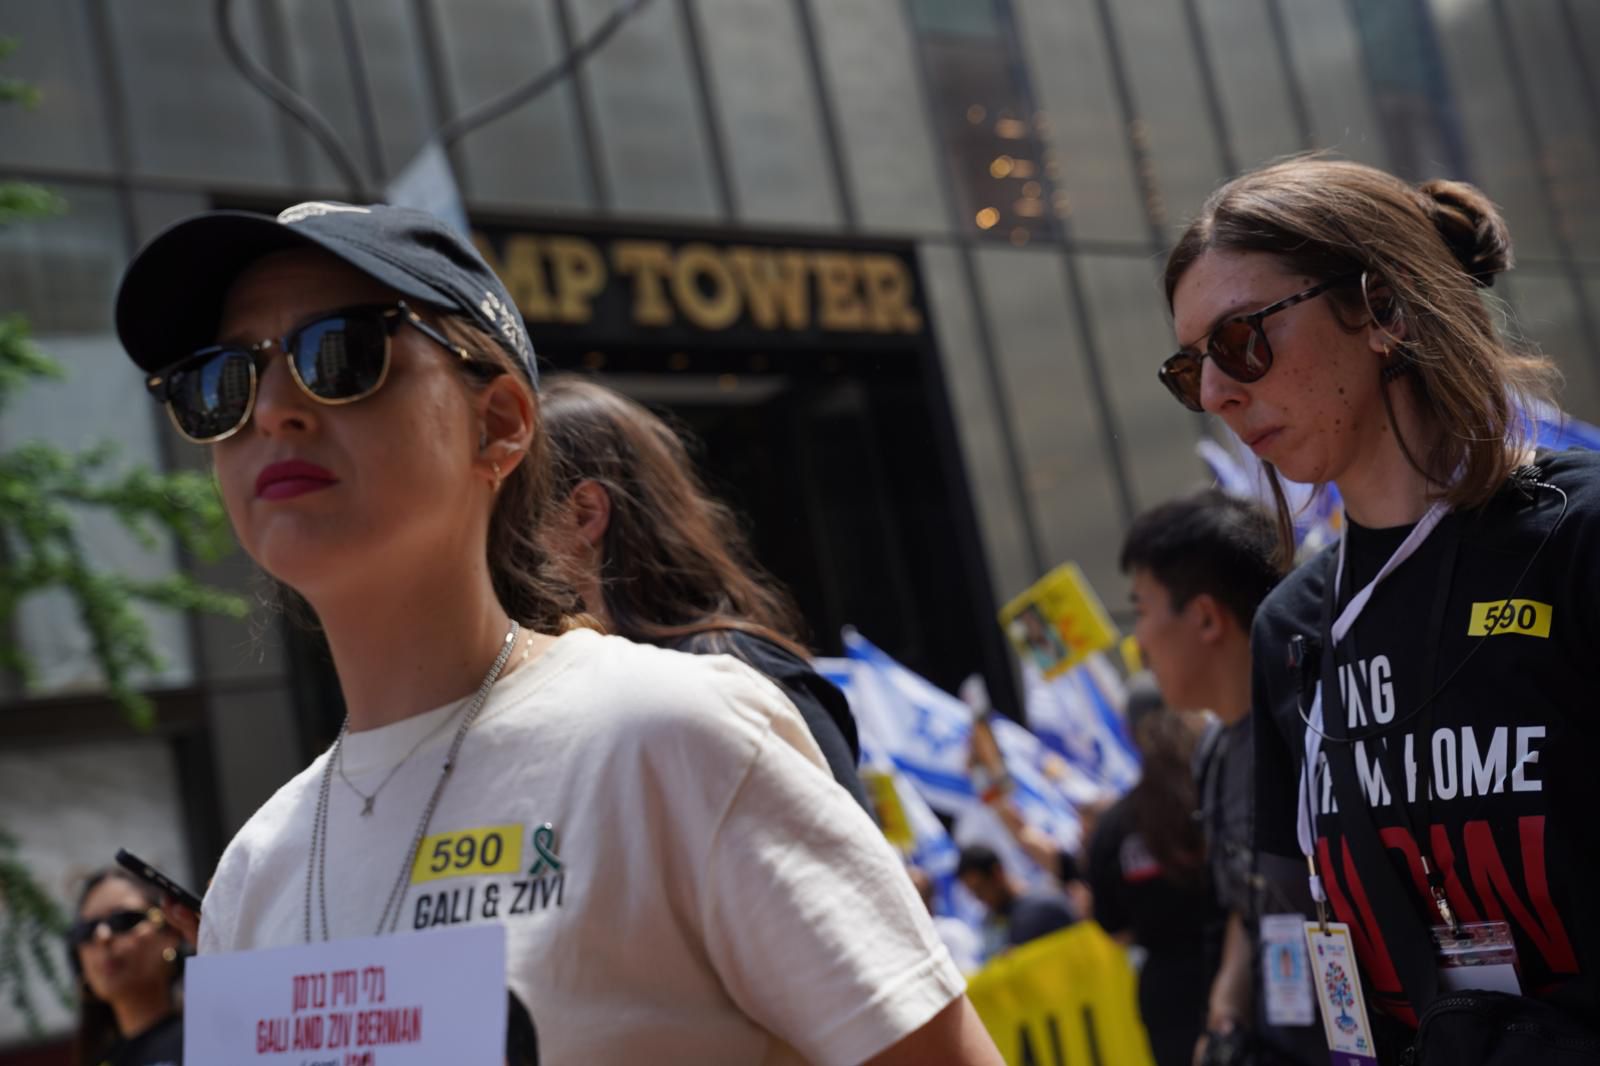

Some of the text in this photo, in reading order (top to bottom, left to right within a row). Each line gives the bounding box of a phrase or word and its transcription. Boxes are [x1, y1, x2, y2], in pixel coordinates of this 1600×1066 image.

[612, 241, 923, 332] TOWER
[1484, 604, 1537, 631] 590
[431, 832, 504, 873] 590
[414, 886, 475, 931] GALI
[482, 882, 500, 919] &
[256, 1004, 423, 1055] GALI AND ZIV BERMAN
